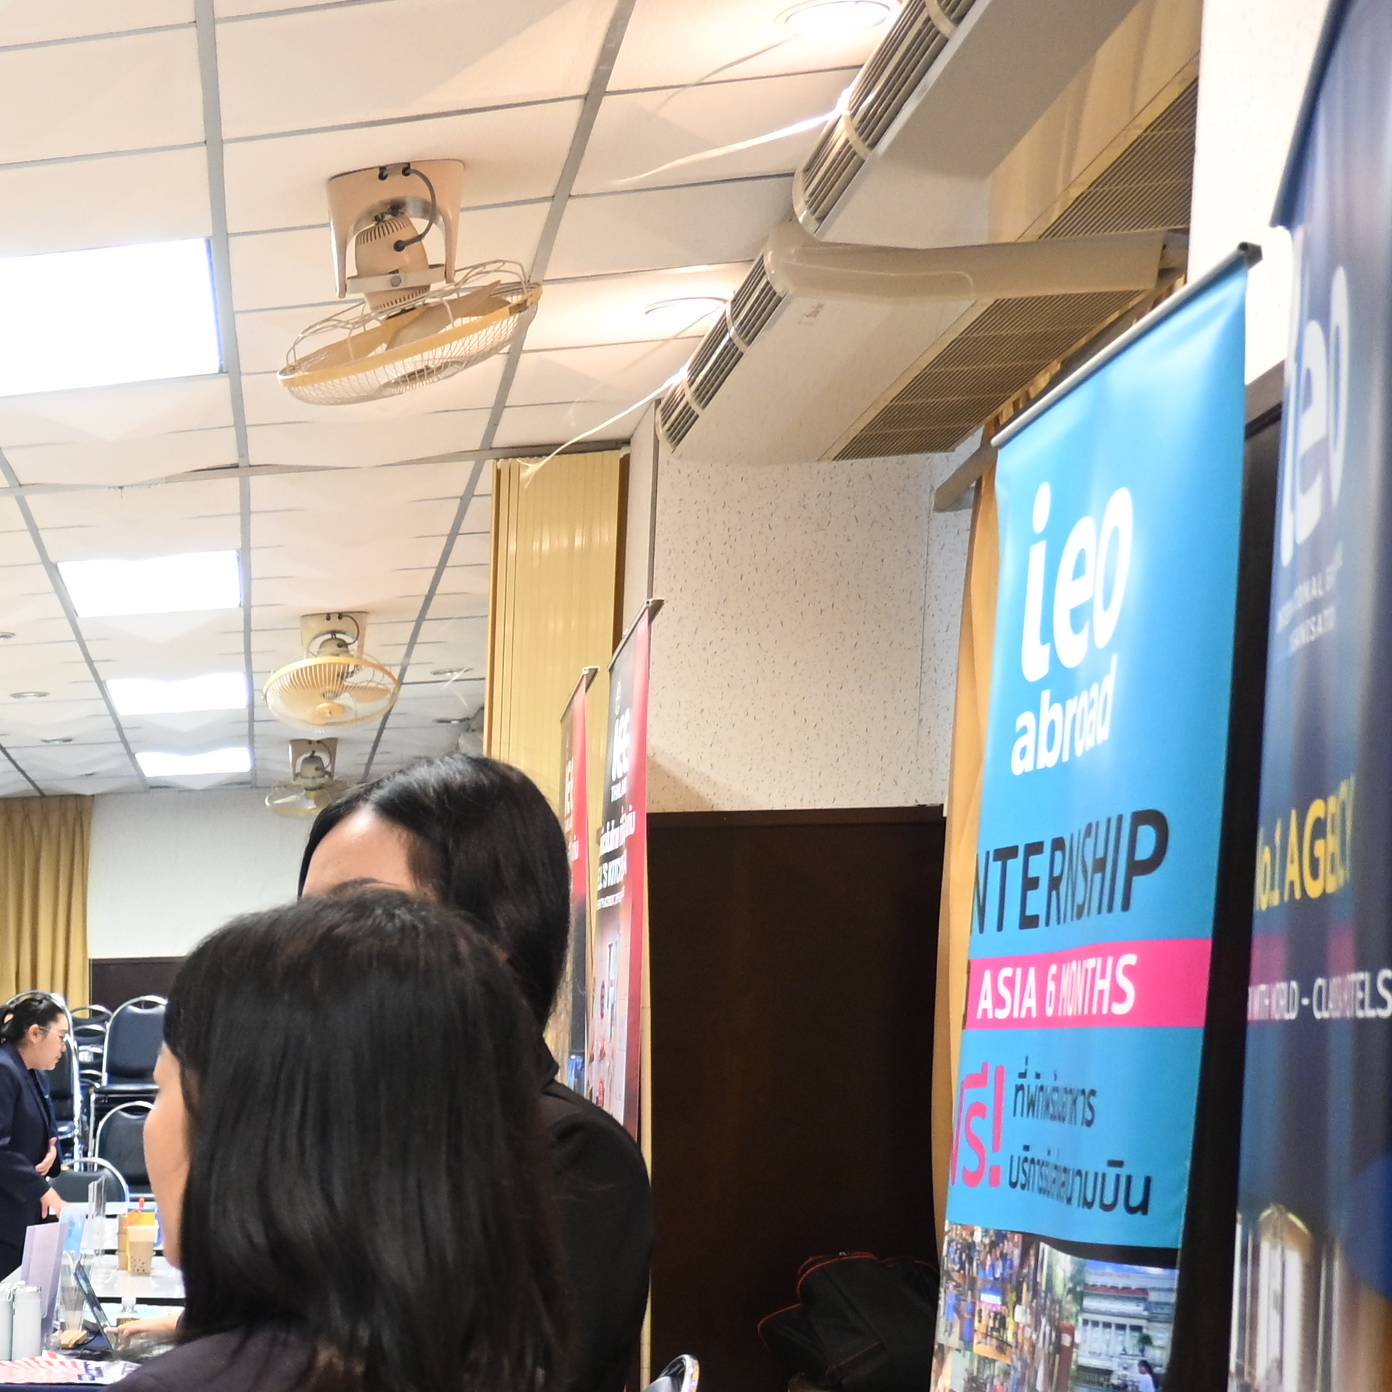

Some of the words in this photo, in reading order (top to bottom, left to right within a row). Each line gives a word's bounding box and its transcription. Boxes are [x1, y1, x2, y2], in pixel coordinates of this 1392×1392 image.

[1022, 481, 1133, 682] ieo
[1011, 653, 1118, 776] abroad
[976, 967, 1037, 1019] ASIA
[1045, 964, 1057, 1017] 6
[1058, 954, 1138, 1017] MONTHS
